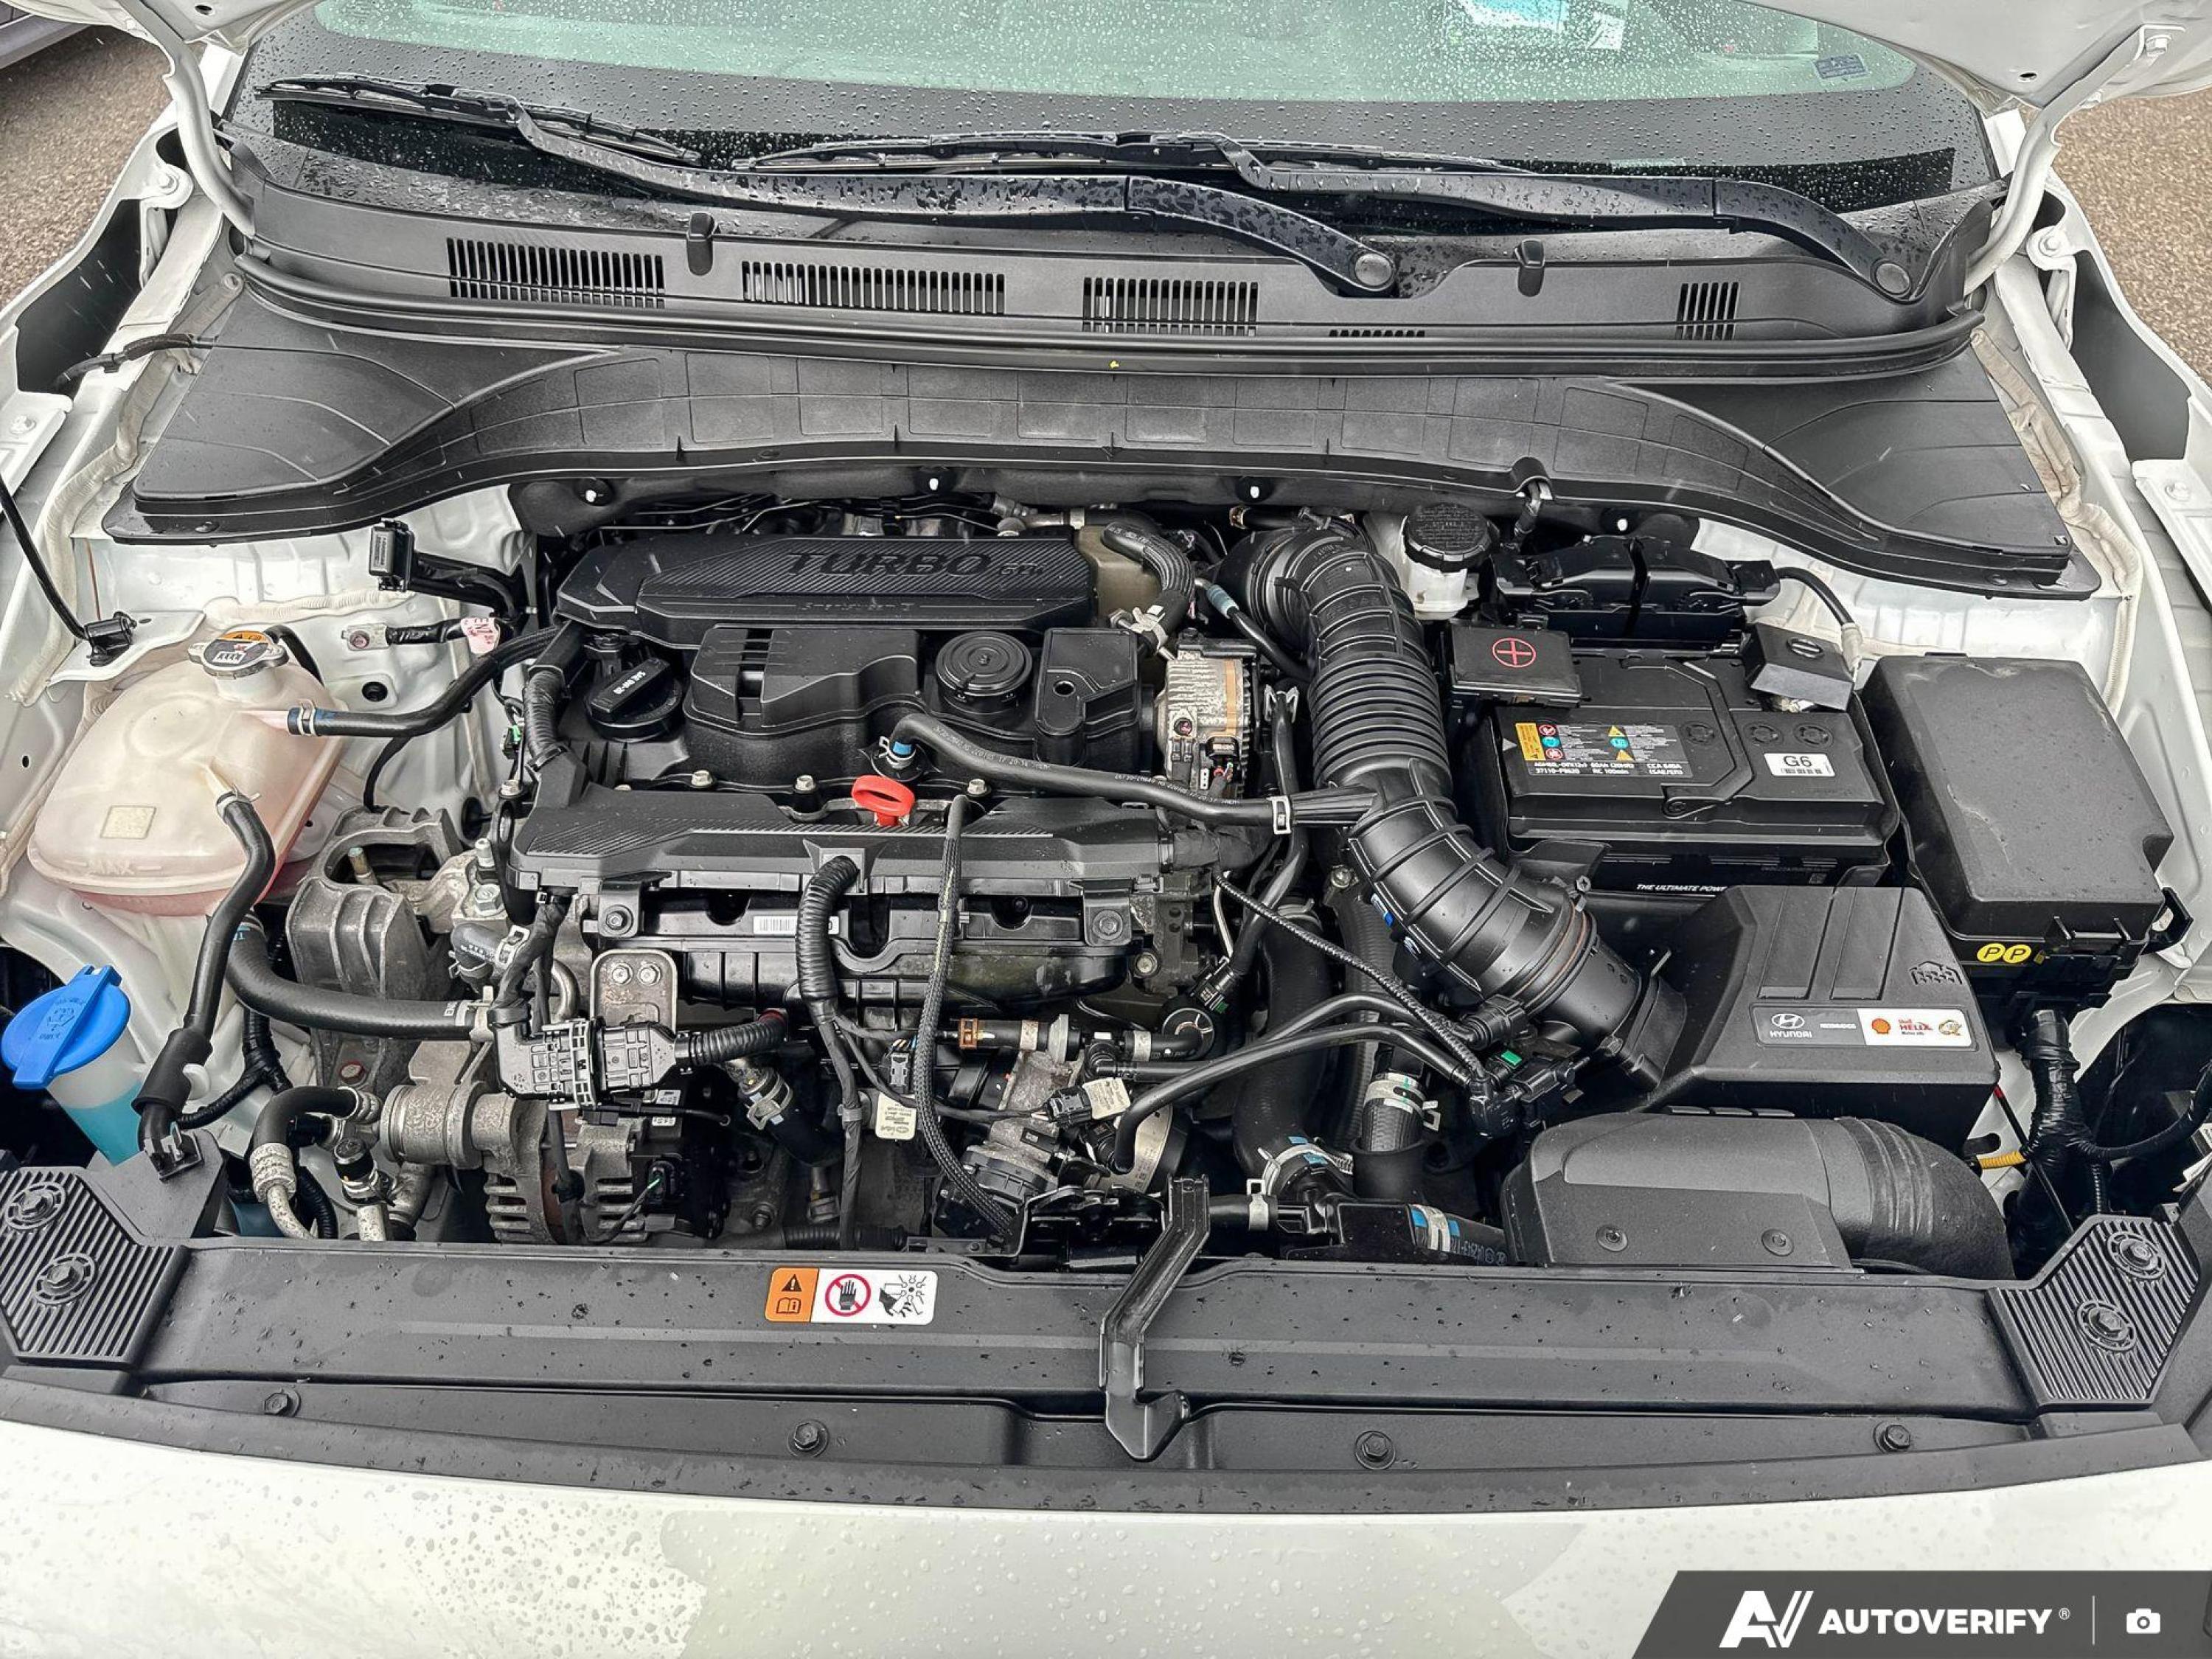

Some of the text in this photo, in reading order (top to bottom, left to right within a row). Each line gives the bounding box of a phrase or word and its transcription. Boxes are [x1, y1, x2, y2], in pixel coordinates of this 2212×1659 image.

[789, 554, 990, 577] TURBO
[1783, 755, 1813, 768] G6
[1984, 947, 2026, 960] P P
[1899, 1023, 1933, 1031] HELIX
[1770, 1030, 1813, 1038] HYUNDAI
